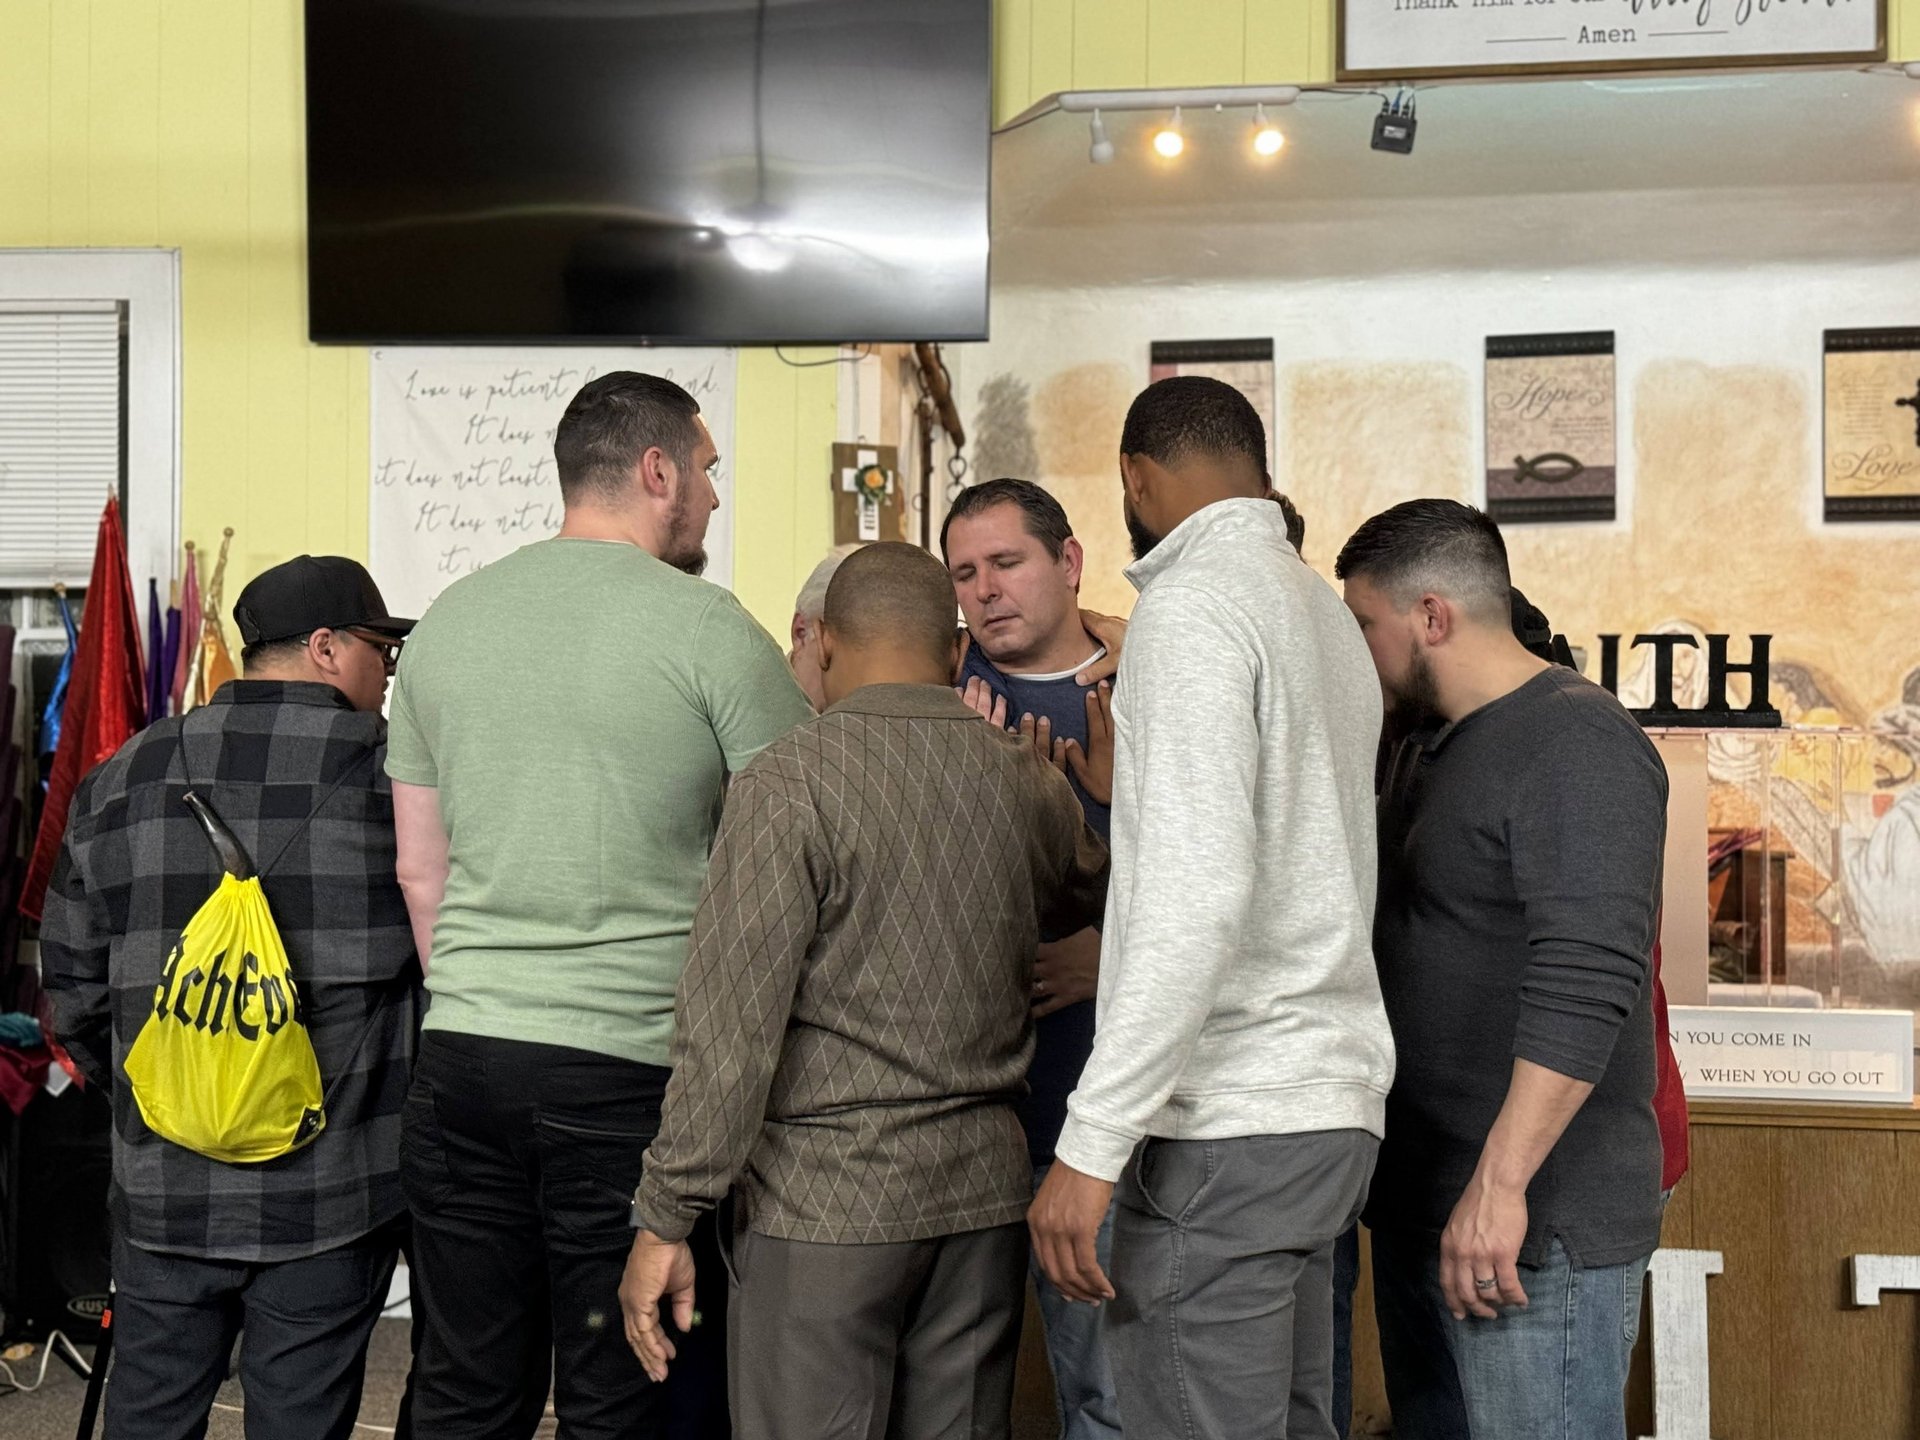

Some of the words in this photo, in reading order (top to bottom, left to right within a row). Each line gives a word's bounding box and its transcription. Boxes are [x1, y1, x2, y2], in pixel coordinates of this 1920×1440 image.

[1577, 25, 1636, 44] Amen
[405, 369, 450, 401] Love
[459, 384, 478, 399] is
[486, 368, 578, 411] patient
[1493, 374, 1604, 421] Hope
[465, 413, 498, 445] It
[498, 417, 535, 445] does
[375, 457, 406, 487] it
[405, 460, 441, 488] does
[453, 456, 498, 490] not
[1832, 443, 1920, 491] Love
[415, 501, 450, 532] It
[449, 505, 487, 532] does
[496, 501, 543, 535] not
[437, 544, 470, 574] it
[1688, 1031, 1725, 1045] YOU
[1731, 1032, 1785, 1047] COME
[1793, 1034, 1812, 1047] IN
[1700, 1068, 1756, 1083] WHEN
[1763, 1070, 1801, 1084] YOU
[1807, 1071, 1836, 1085] GO
[1843, 1072, 1884, 1086] OUT
[76, 1300, 108, 1313] KUS
